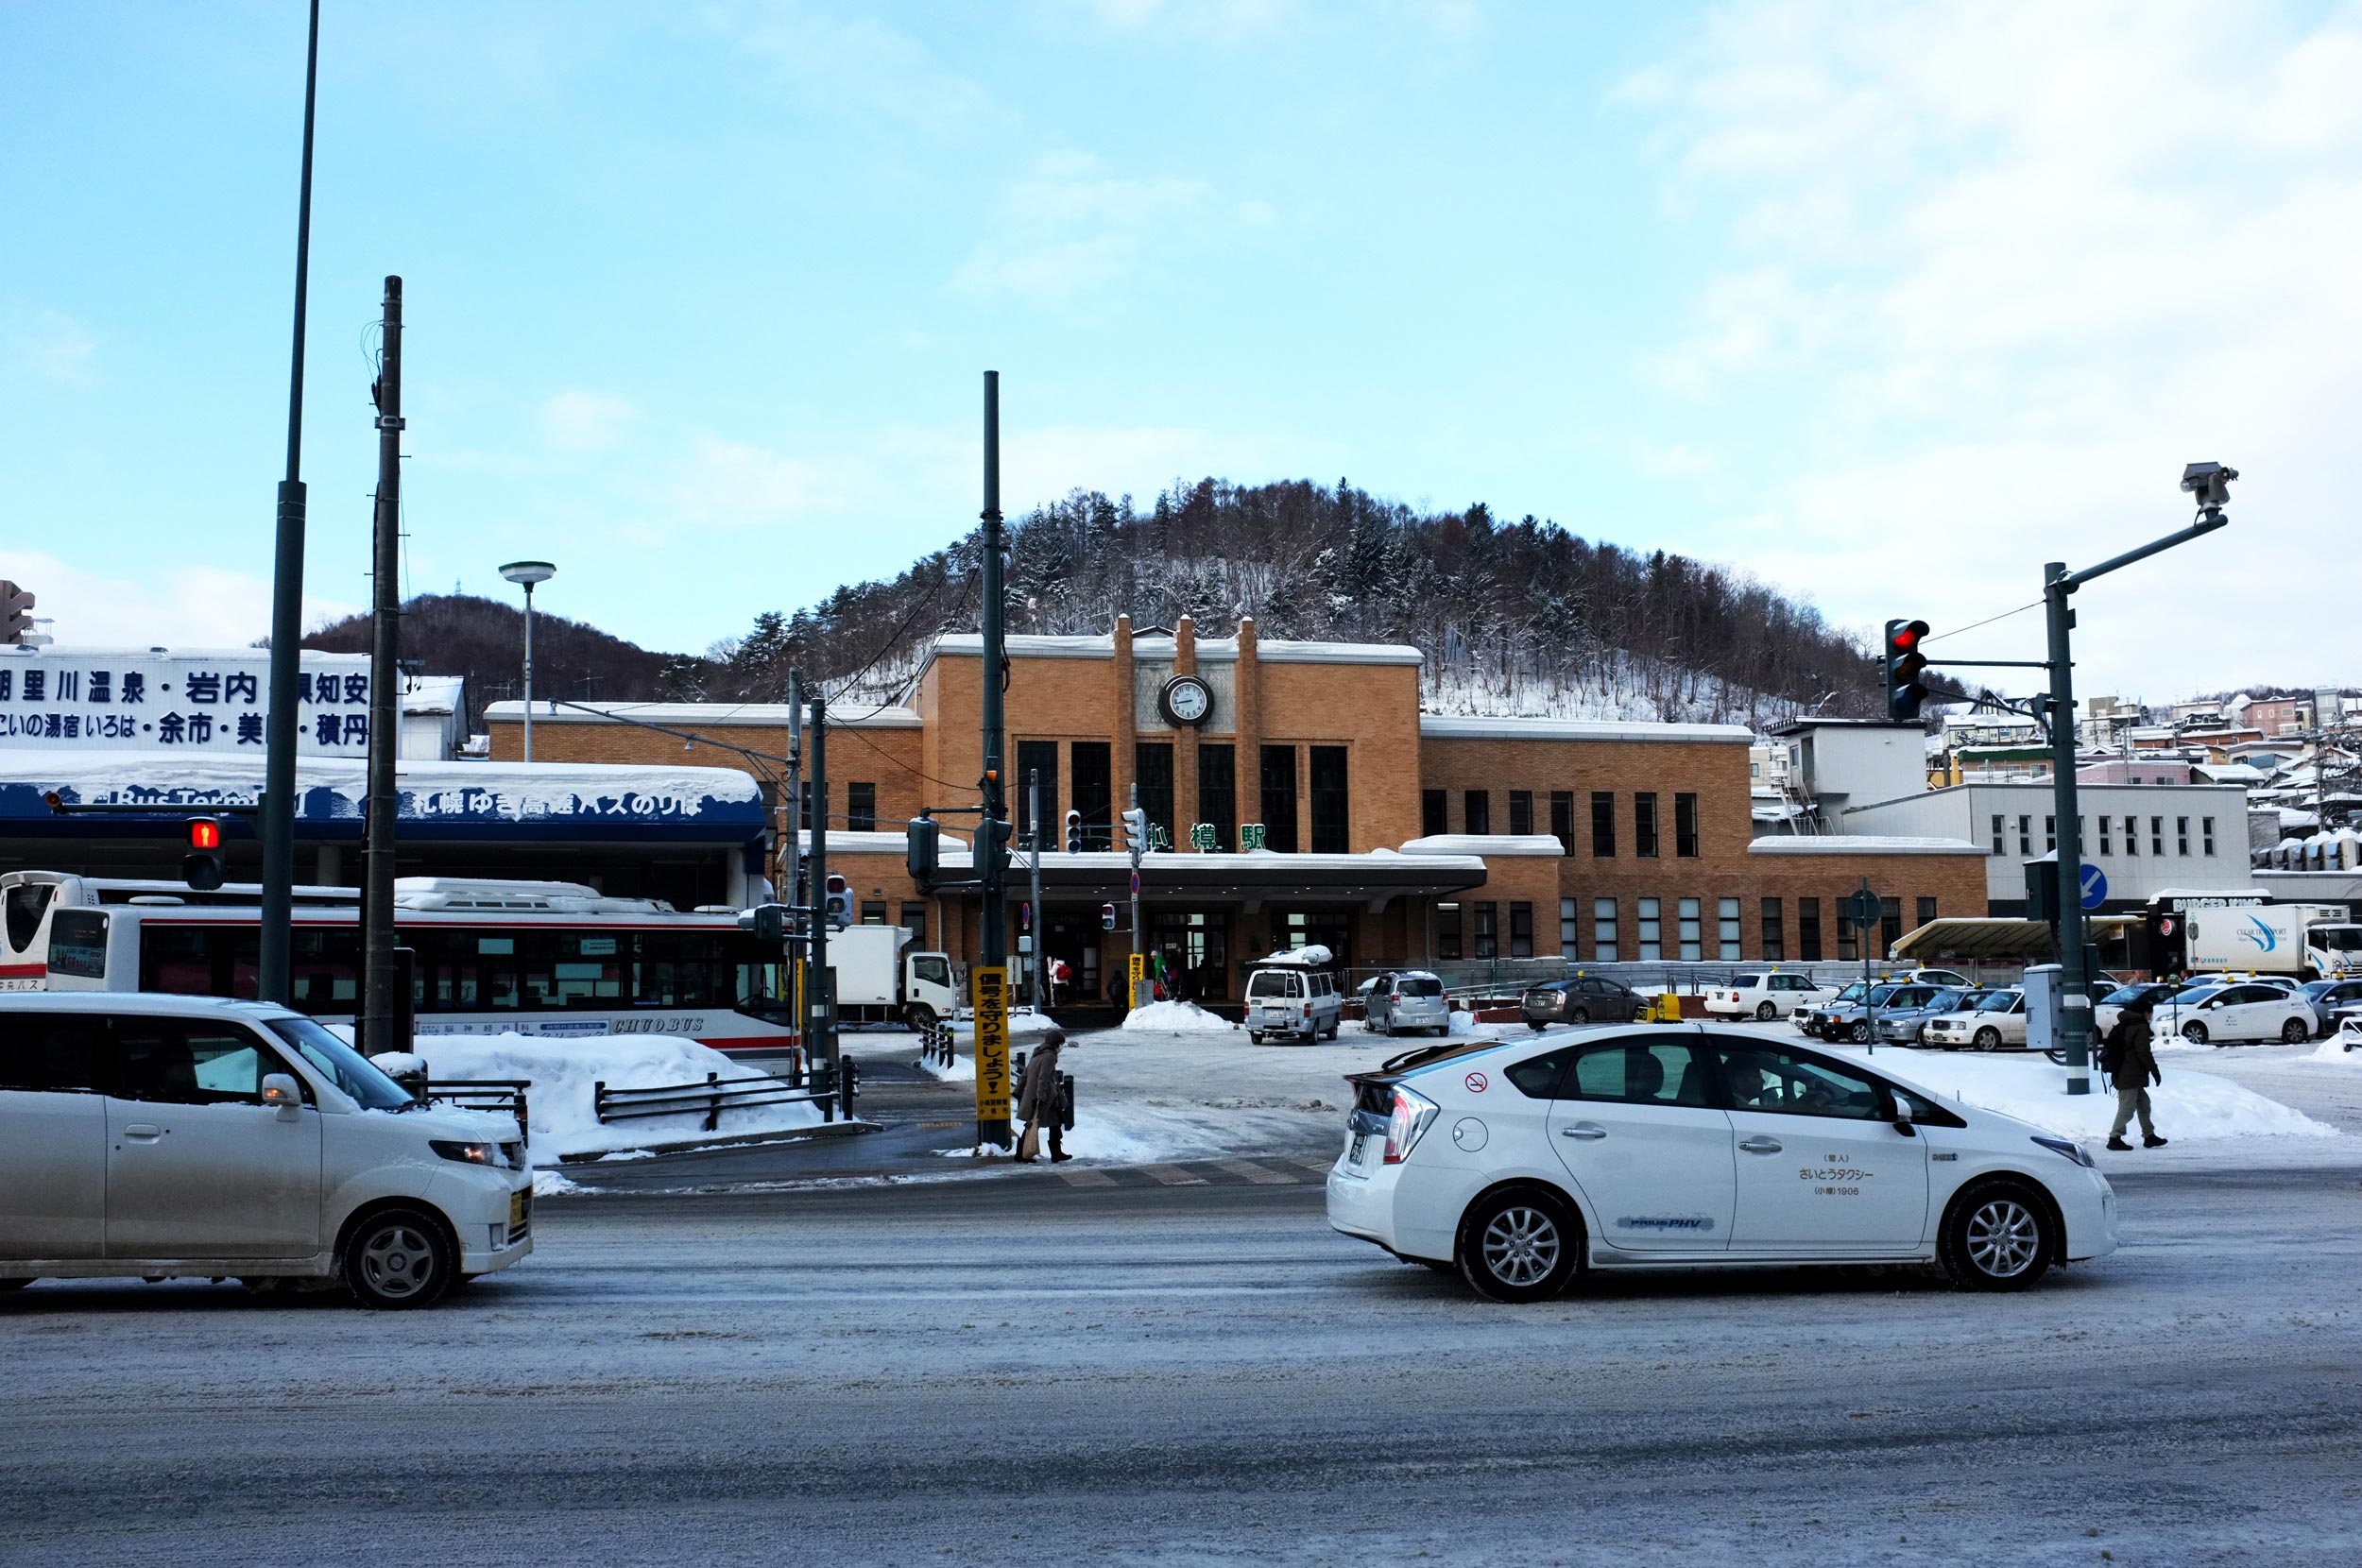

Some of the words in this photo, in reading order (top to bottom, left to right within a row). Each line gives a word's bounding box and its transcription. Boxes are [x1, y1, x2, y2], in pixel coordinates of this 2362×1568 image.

[177, 790, 307, 816] Termil
[1148, 823, 1266, 851] 小樽駅
[2173, 898, 2227, 912] BURGER
[2228, 898, 2263, 907] KING
[1799, 1168, 1874, 1181] さいとうタクシー
[1668, 1219, 1702, 1228] PHV
